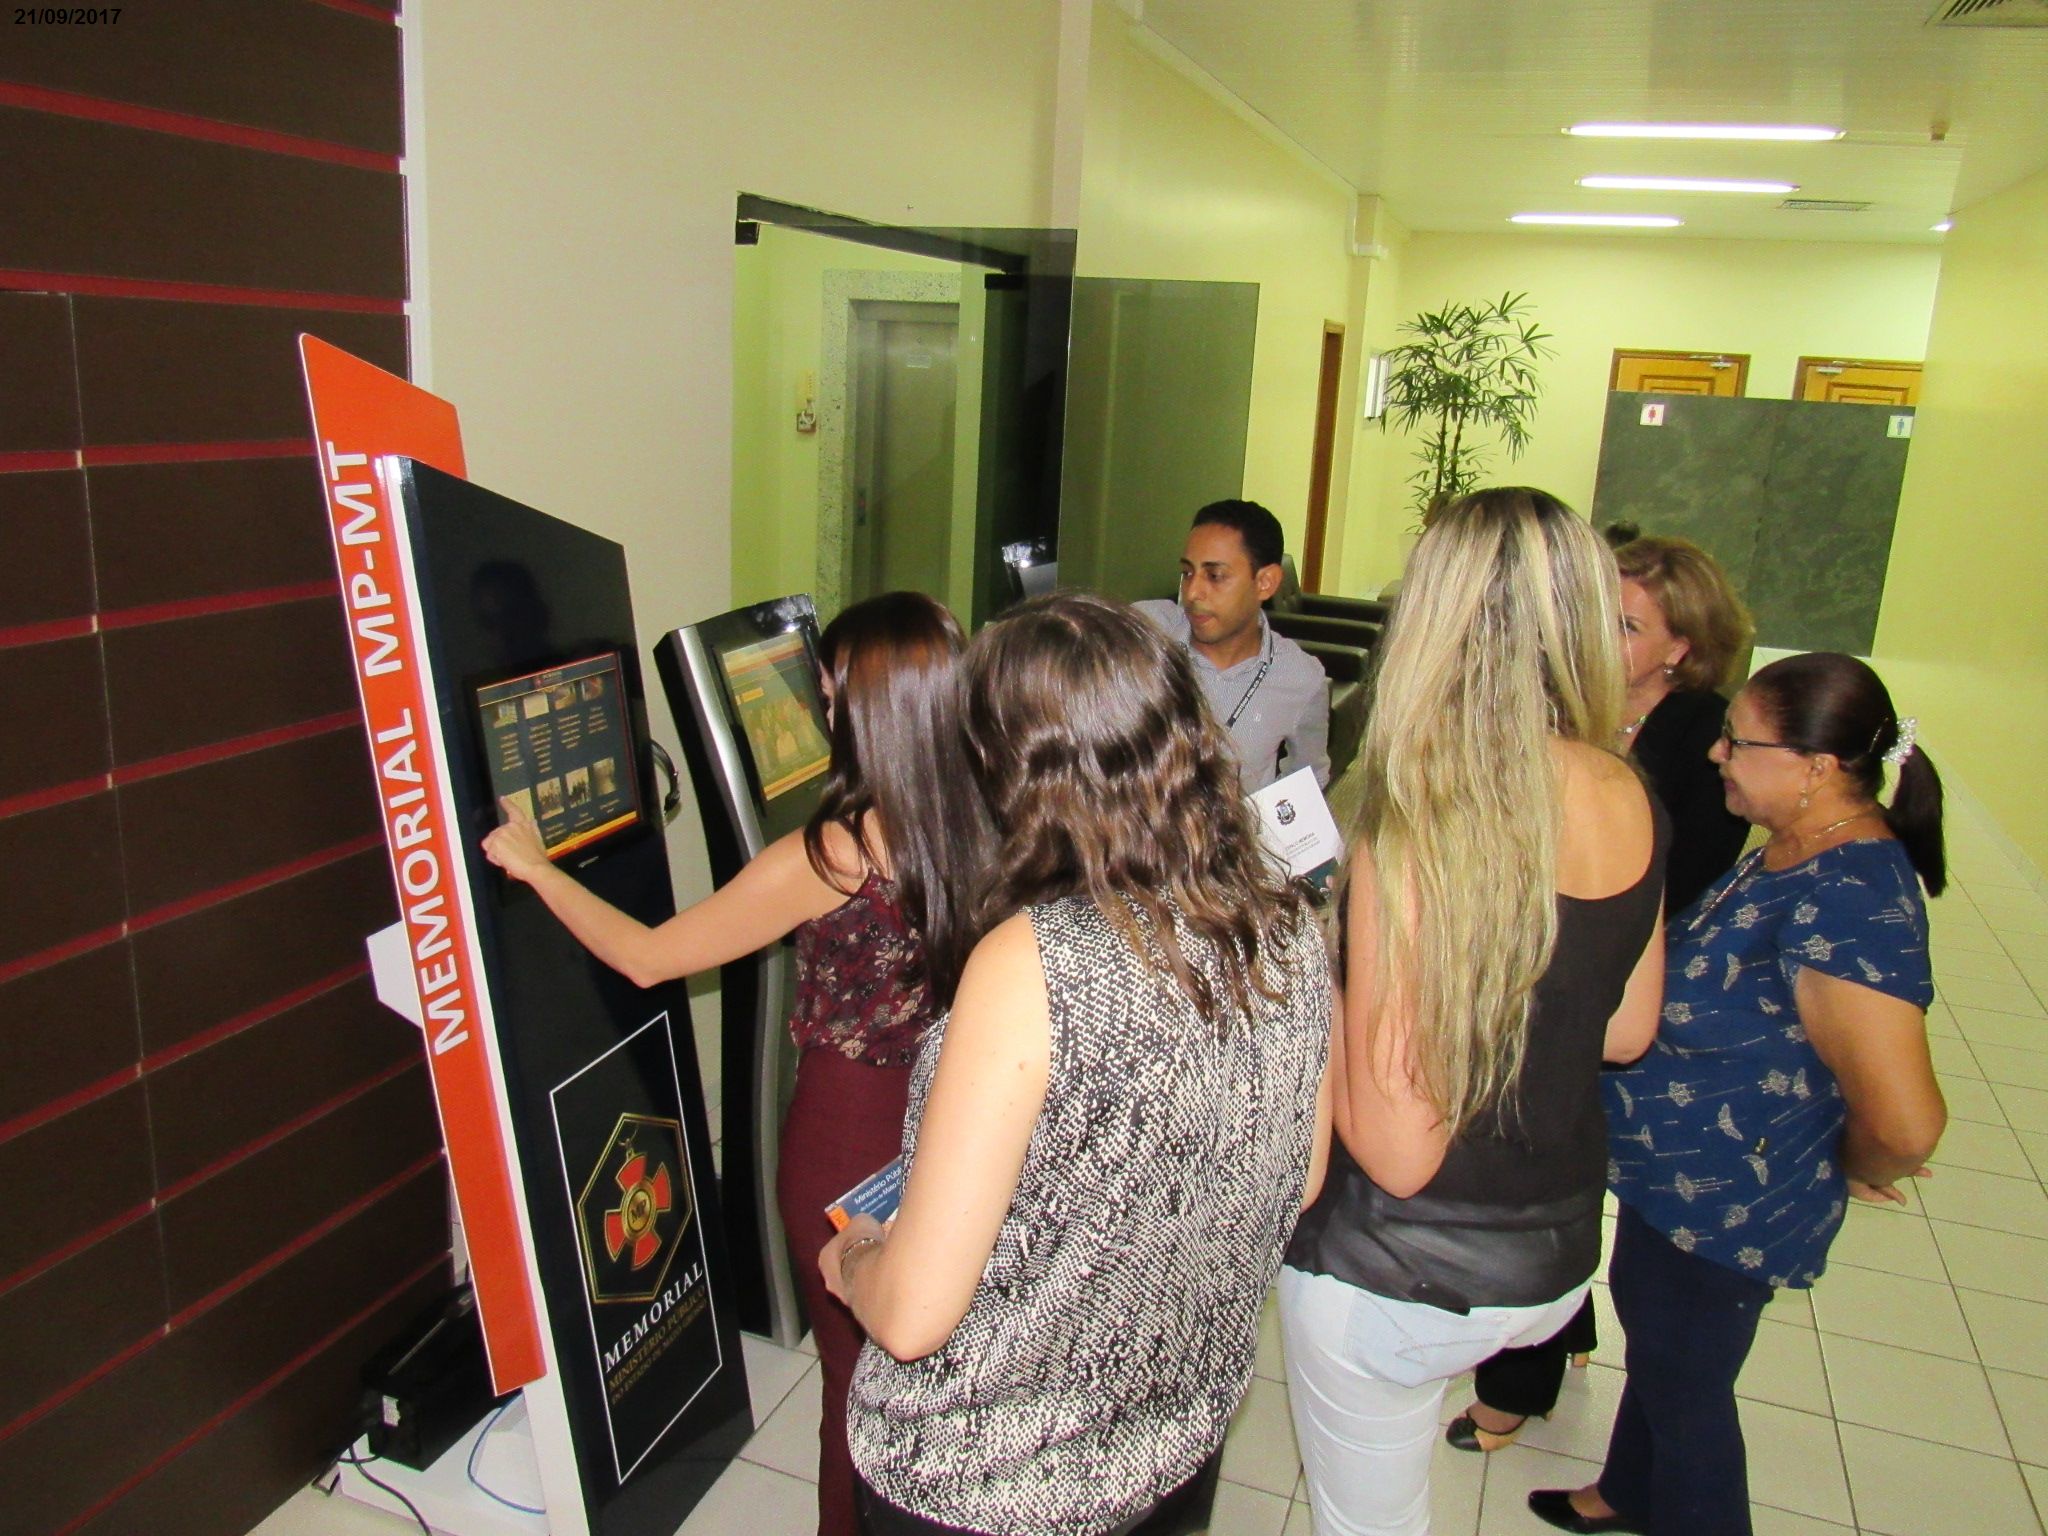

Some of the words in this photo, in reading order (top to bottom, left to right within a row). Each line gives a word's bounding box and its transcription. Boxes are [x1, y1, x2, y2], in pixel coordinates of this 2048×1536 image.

[326, 440, 402, 677] MP-MT
[377, 706, 469, 1056] MEMORIAL
[854, 1180, 887, 1205] Ministério
[603, 1261, 704, 1374] MEMORIAL
